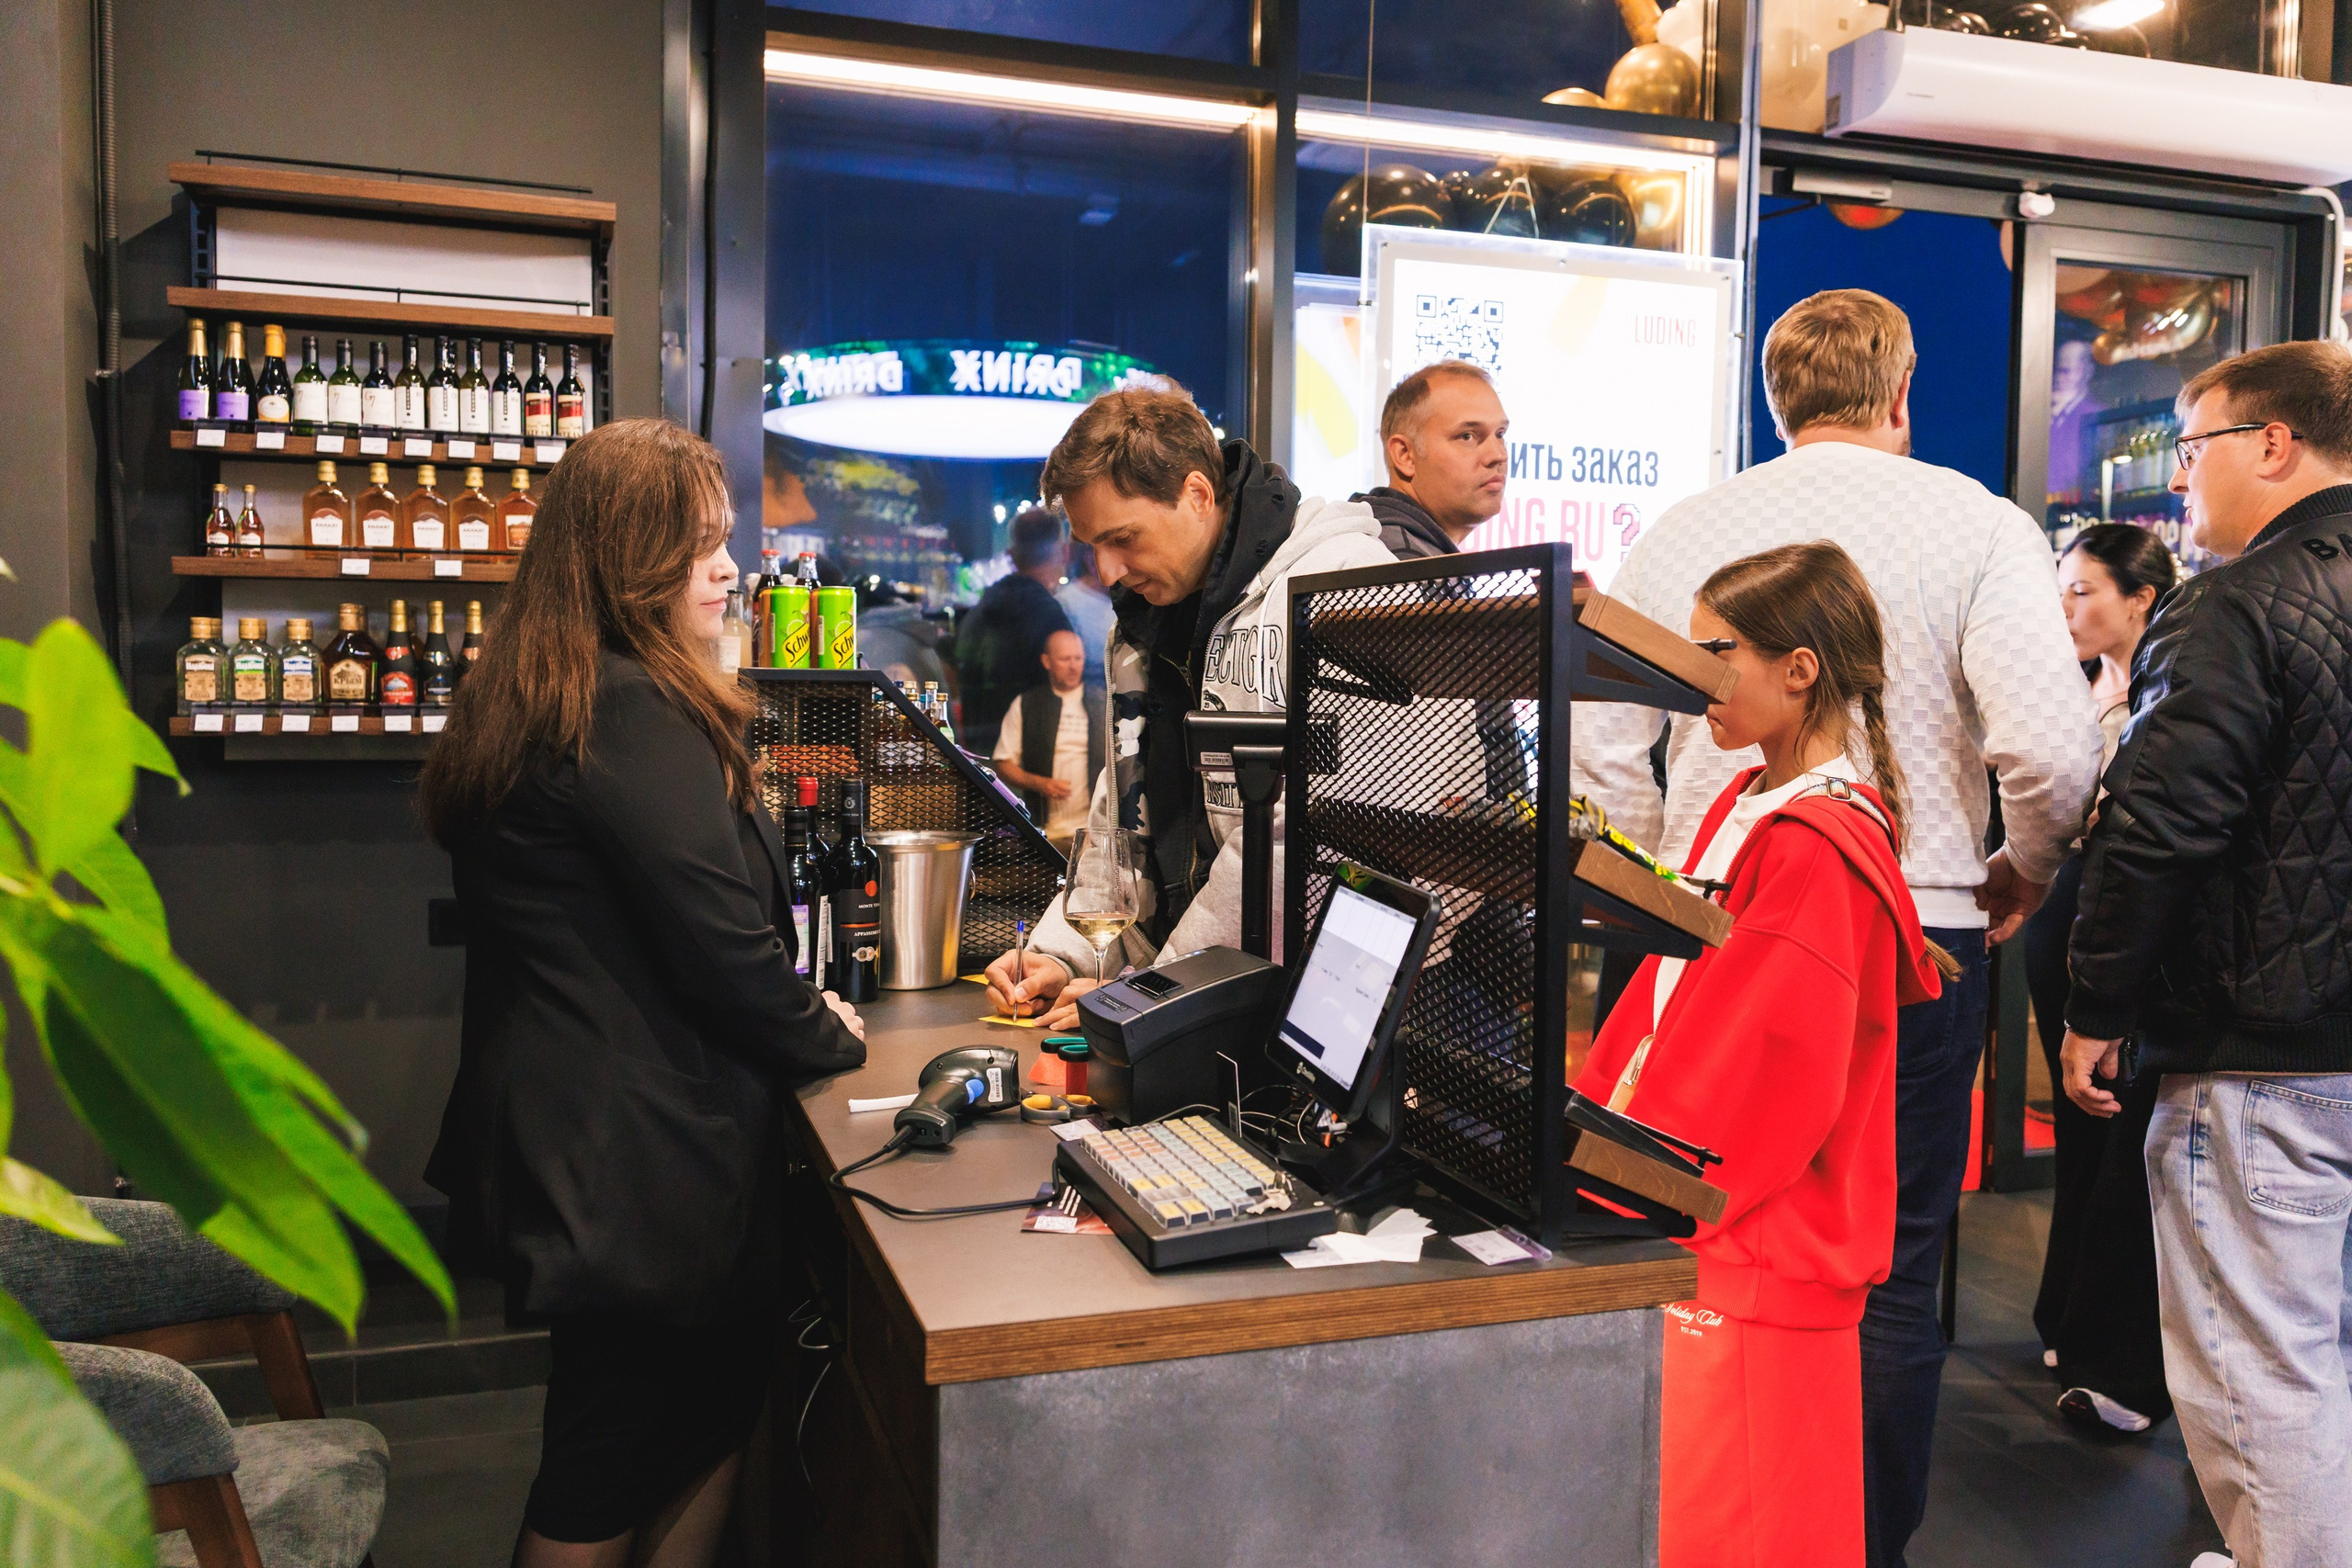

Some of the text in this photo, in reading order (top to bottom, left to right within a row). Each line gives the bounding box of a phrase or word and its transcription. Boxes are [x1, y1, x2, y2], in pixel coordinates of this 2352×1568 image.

[1634, 314, 1696, 347] LUDING
[1510, 442, 1659, 487] ить заказ
[1206, 781, 1243, 808] RSIT
[1696, 1309, 1724, 1326] Club
